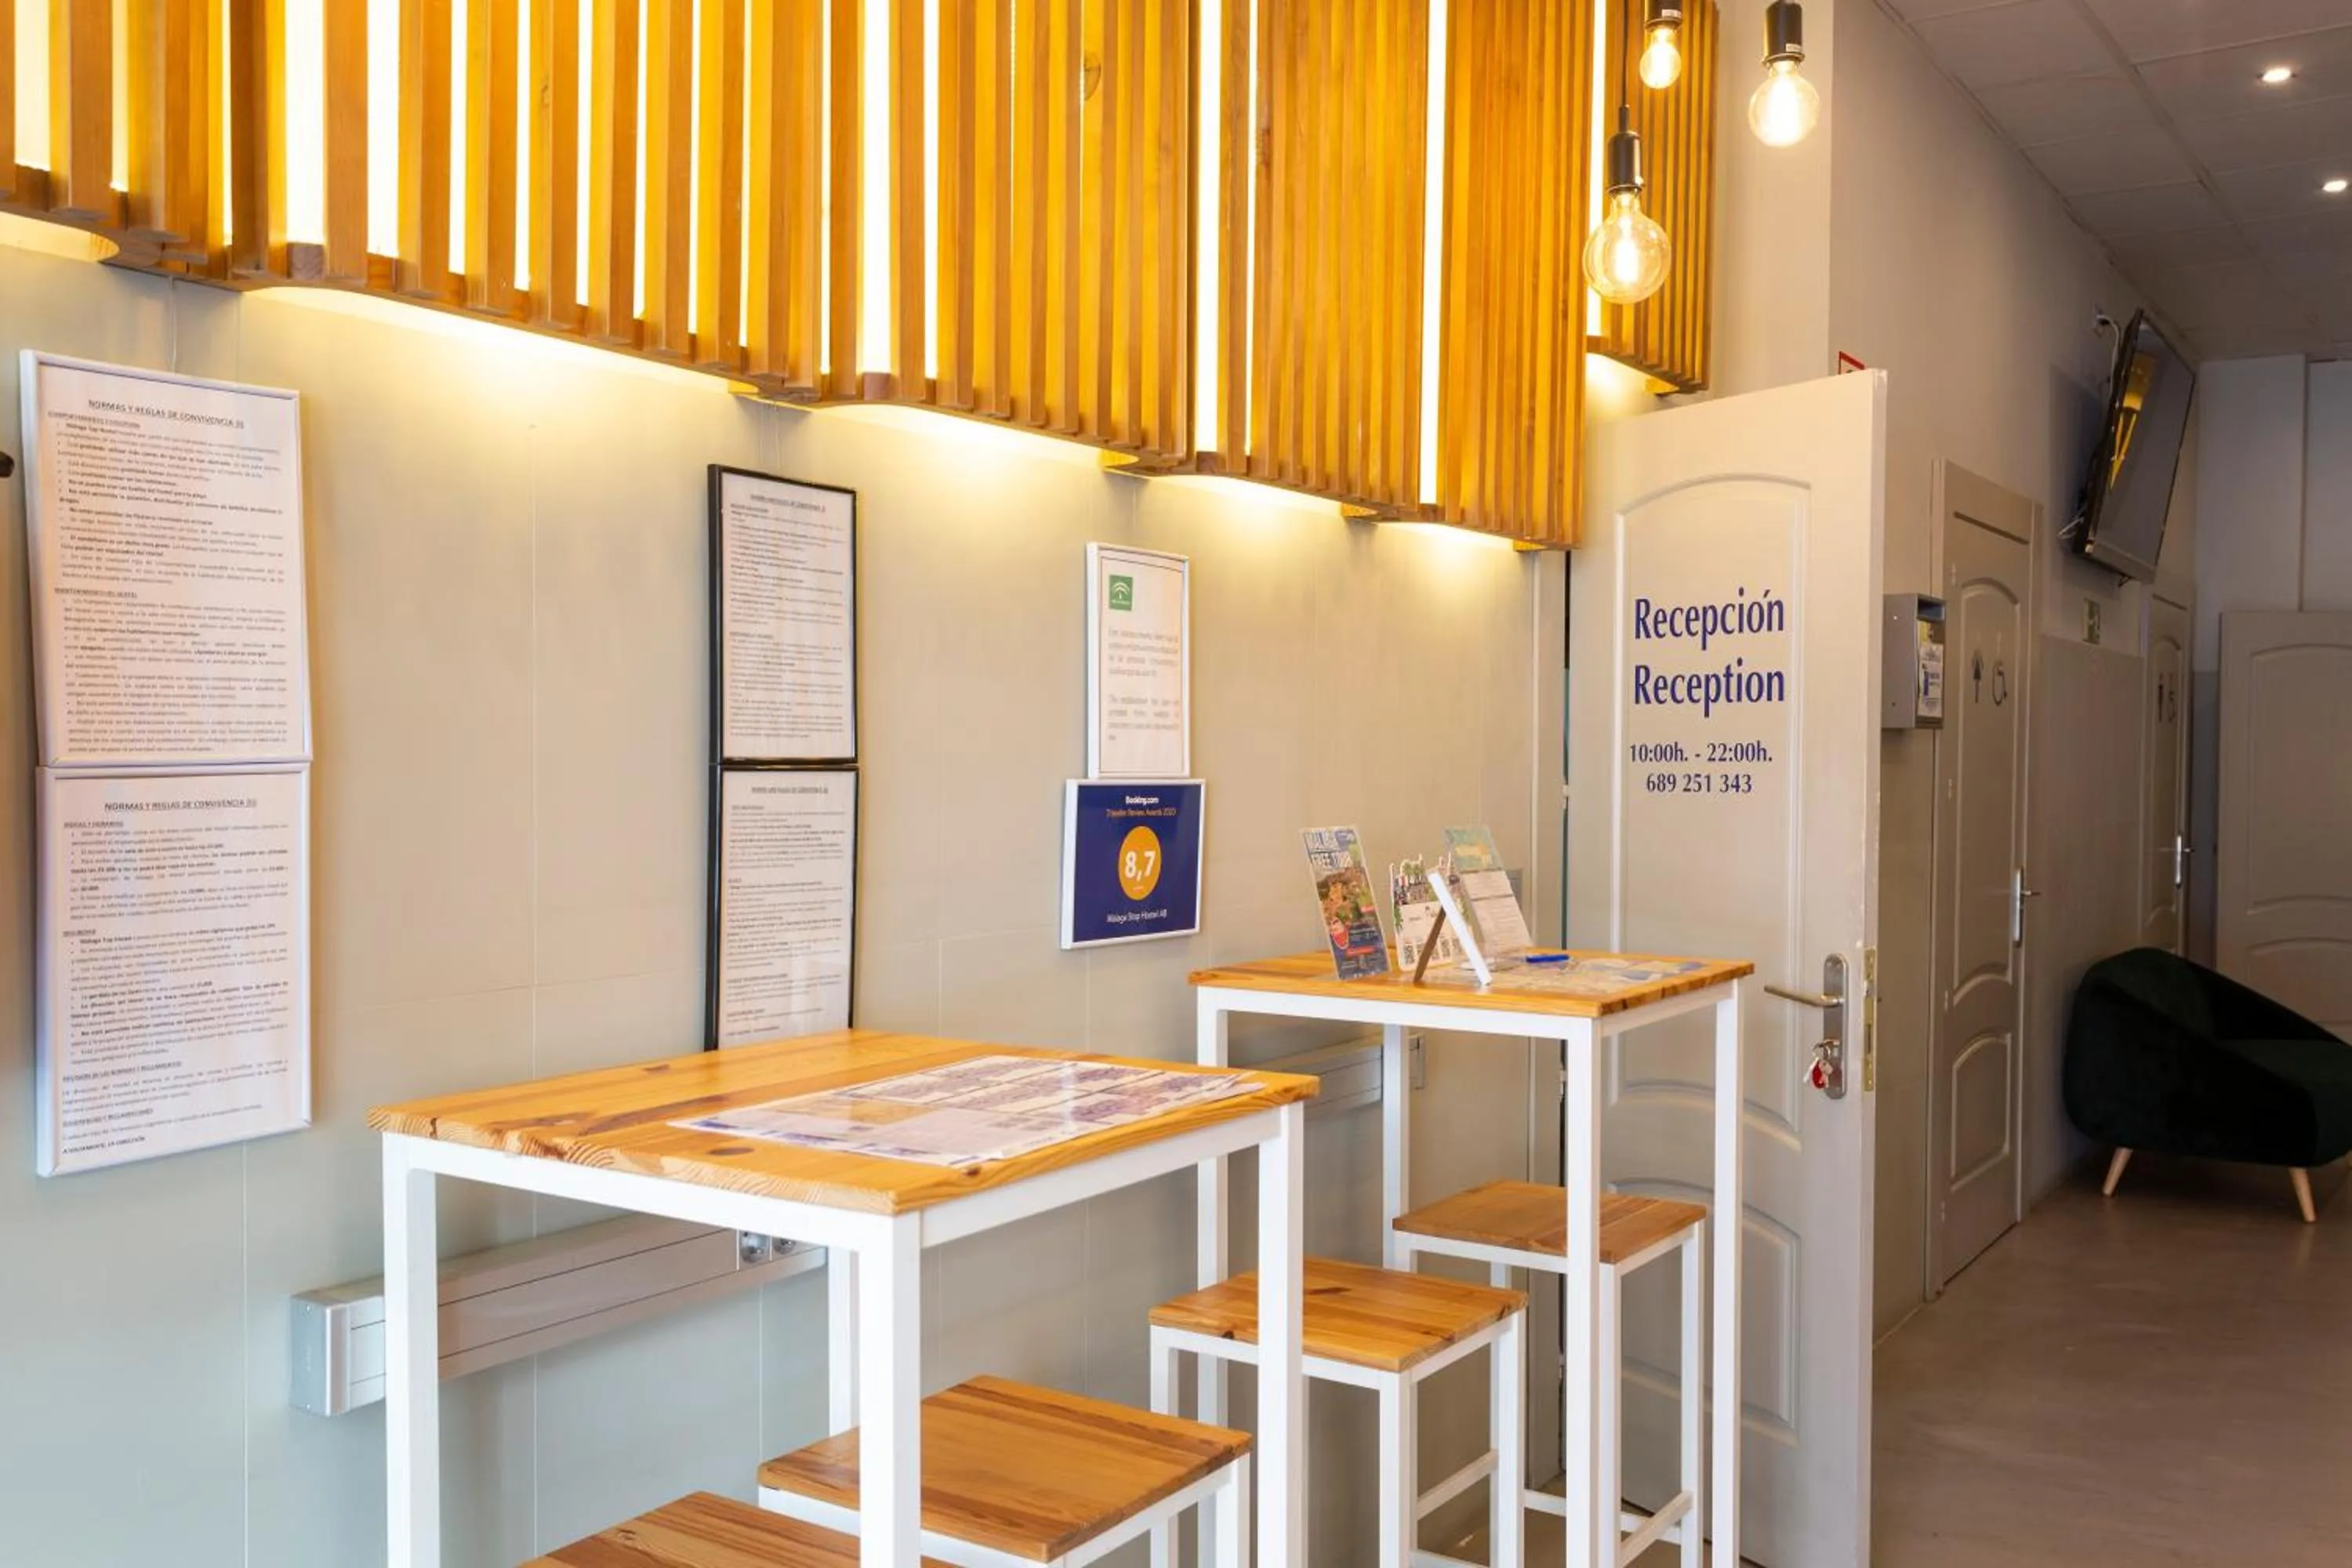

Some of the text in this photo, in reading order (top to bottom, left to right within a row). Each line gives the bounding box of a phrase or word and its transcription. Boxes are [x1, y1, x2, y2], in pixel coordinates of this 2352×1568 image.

[1635, 586, 1784, 651] Recepción
[1634, 657, 1785, 718] Reception
[1630, 741, 1689, 763] 10:00h.
[1706, 740, 1773, 763] 22:00h.
[1646, 773, 1752, 793] 689 251 343
[104, 800, 143, 811] NORMAS
[1125, 796, 1159, 805] Booking.com
[1124, 849, 1156, 881] 8,7
